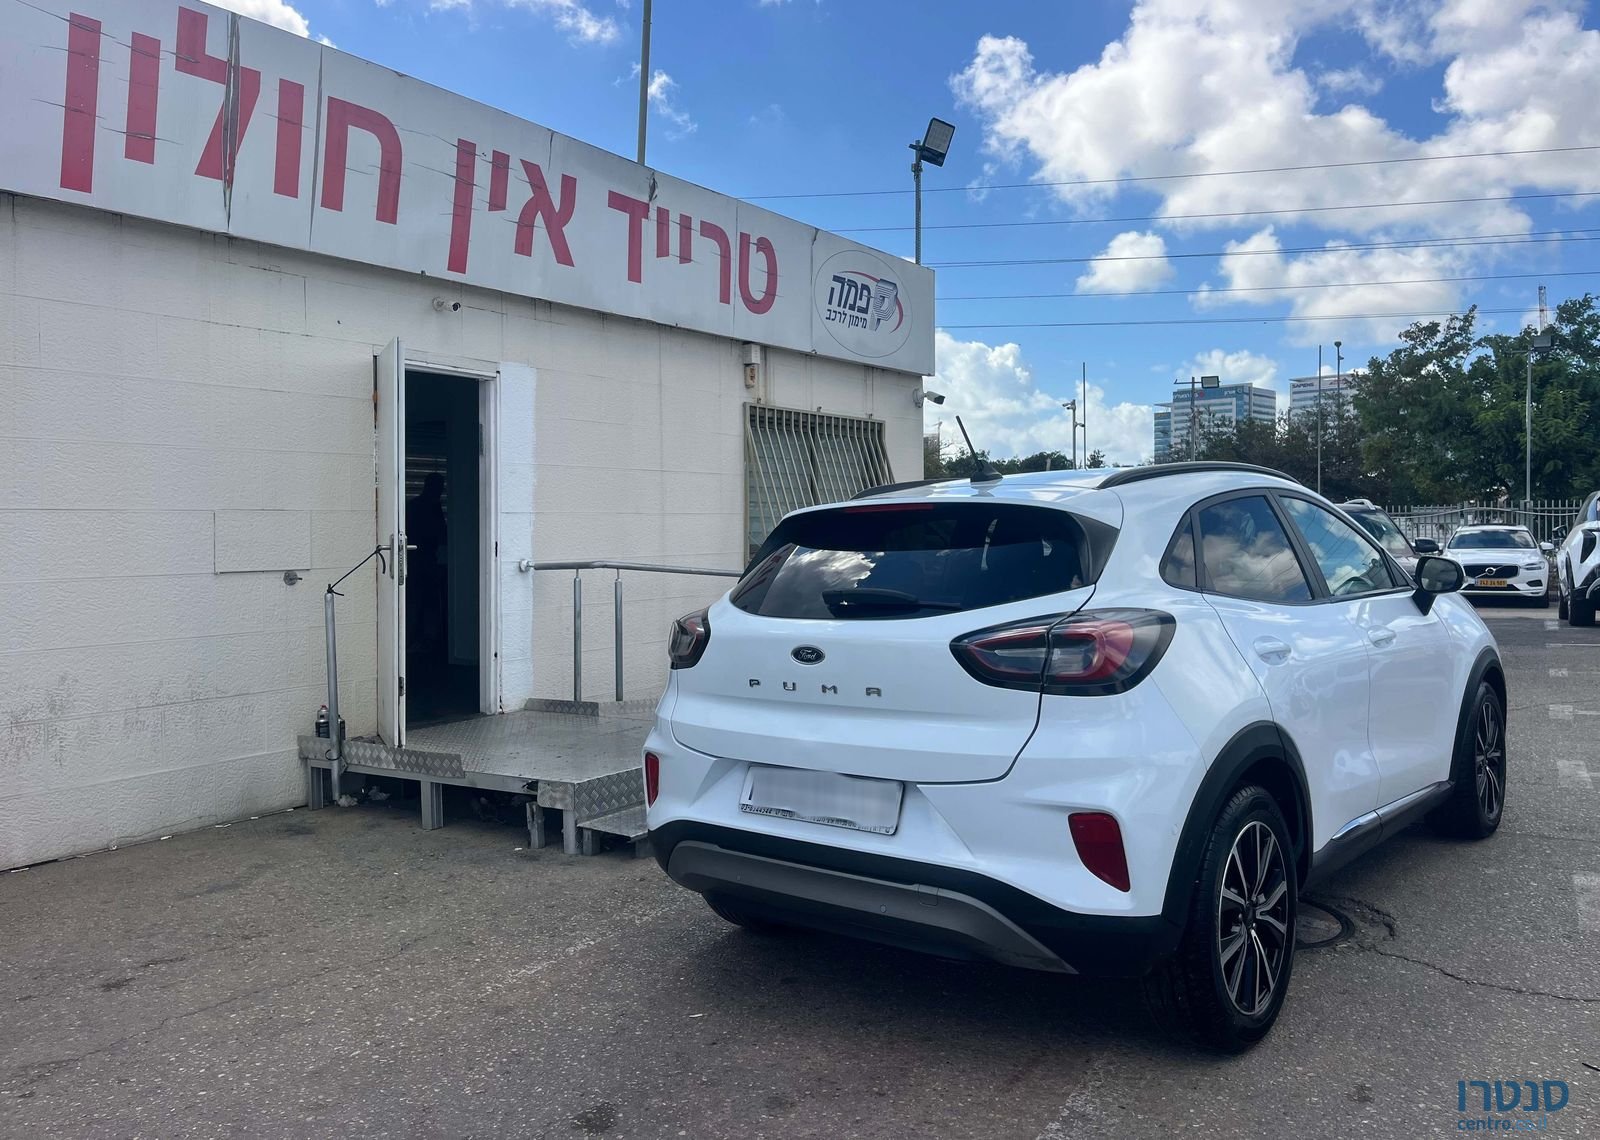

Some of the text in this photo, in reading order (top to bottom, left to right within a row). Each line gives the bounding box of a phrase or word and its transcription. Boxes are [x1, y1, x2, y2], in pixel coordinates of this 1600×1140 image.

[59, 5, 778, 315] טרייד אין חולון
[827, 274, 872, 315] פמה
[825, 308, 868, 329] מימון לרכב
[748, 678, 882, 697] PUMA
